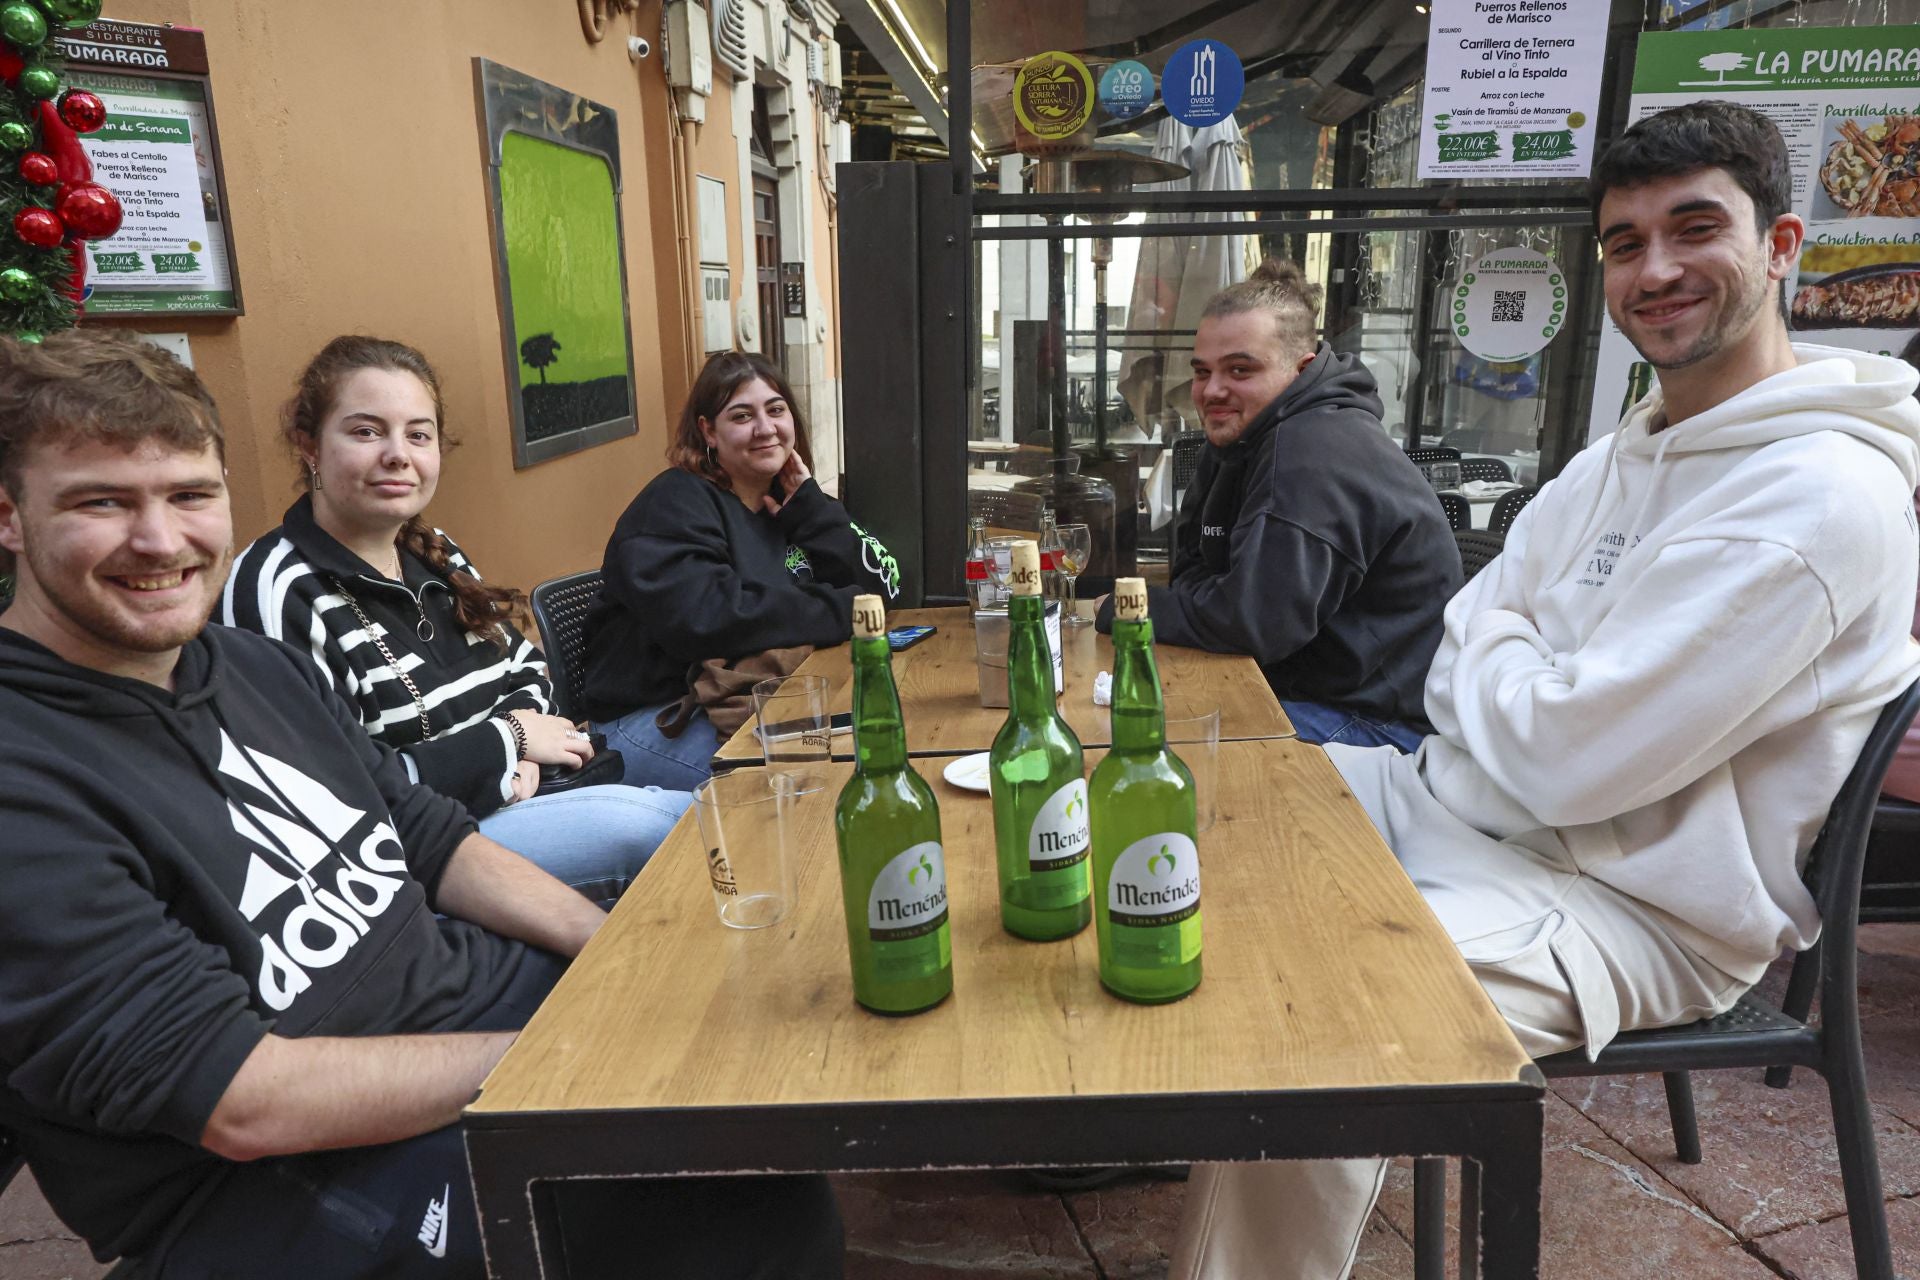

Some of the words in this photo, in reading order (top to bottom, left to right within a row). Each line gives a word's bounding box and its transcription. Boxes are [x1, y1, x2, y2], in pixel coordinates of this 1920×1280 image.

[1474, 2, 1517, 12] Puerros
[1519, 1, 1568, 11] Rellenos
[1487, 14, 1504, 24] de
[1506, 13, 1552, 23] Marisco
[85, 22, 161, 37] RESTAURANTE
[1459, 39, 1511, 49] Carrillera
[1513, 38, 1530, 48] de
[1533, 37, 1575, 48] Ternera
[1481, 51, 1493, 60] al
[1496, 50, 1521, 60] Vino
[1524, 49, 1550, 59] Tinto
[1755, 51, 1789, 74] LA
[1460, 69, 1495, 79] Rubiel
[1498, 71, 1506, 79] a
[1508, 69, 1519, 79] la
[1522, 67, 1568, 80] Espalda
[1112, 84, 1142, 93] creo
[1451, 108, 1472, 116] Vasín
[1487, 107, 1519, 115] Tiramisú
[1520, 107, 1531, 115] de
[1533, 107, 1571, 115] Manzana
[1825, 102, 1907, 117] Parrilladas
[102, 121, 116, 130] in
[119, 121, 134, 131] de
[136, 122, 182, 135] Semana
[1443, 136, 1492, 150] 22,00€
[1521, 135, 1560, 149] 24,00
[91, 150, 119, 158] Fabes
[131, 152, 168, 161] Centollo
[96, 163, 129, 171] Puerros
[131, 164, 167, 174] Rellenos
[123, 173, 158, 181] Marisco
[134, 189, 146, 197] de
[147, 190, 180, 198] Ternera
[146, 210, 180, 219] Espalda
[1817, 231, 1874, 246] Chuletón
[1879, 236, 1888, 244] a
[1893, 232, 1906, 244] la
[1912, 232, 1920, 245] P
[99, 255, 136, 266] 22,00€
[159, 255, 188, 266] 24,00
[1494, 260, 1549, 269] PUMARADA
[1038, 825, 1088, 853] Menén
[877, 883, 947, 921] Menénd
[259, 817, 408, 1011] adida
[417, 1197, 443, 1248] NIKE
